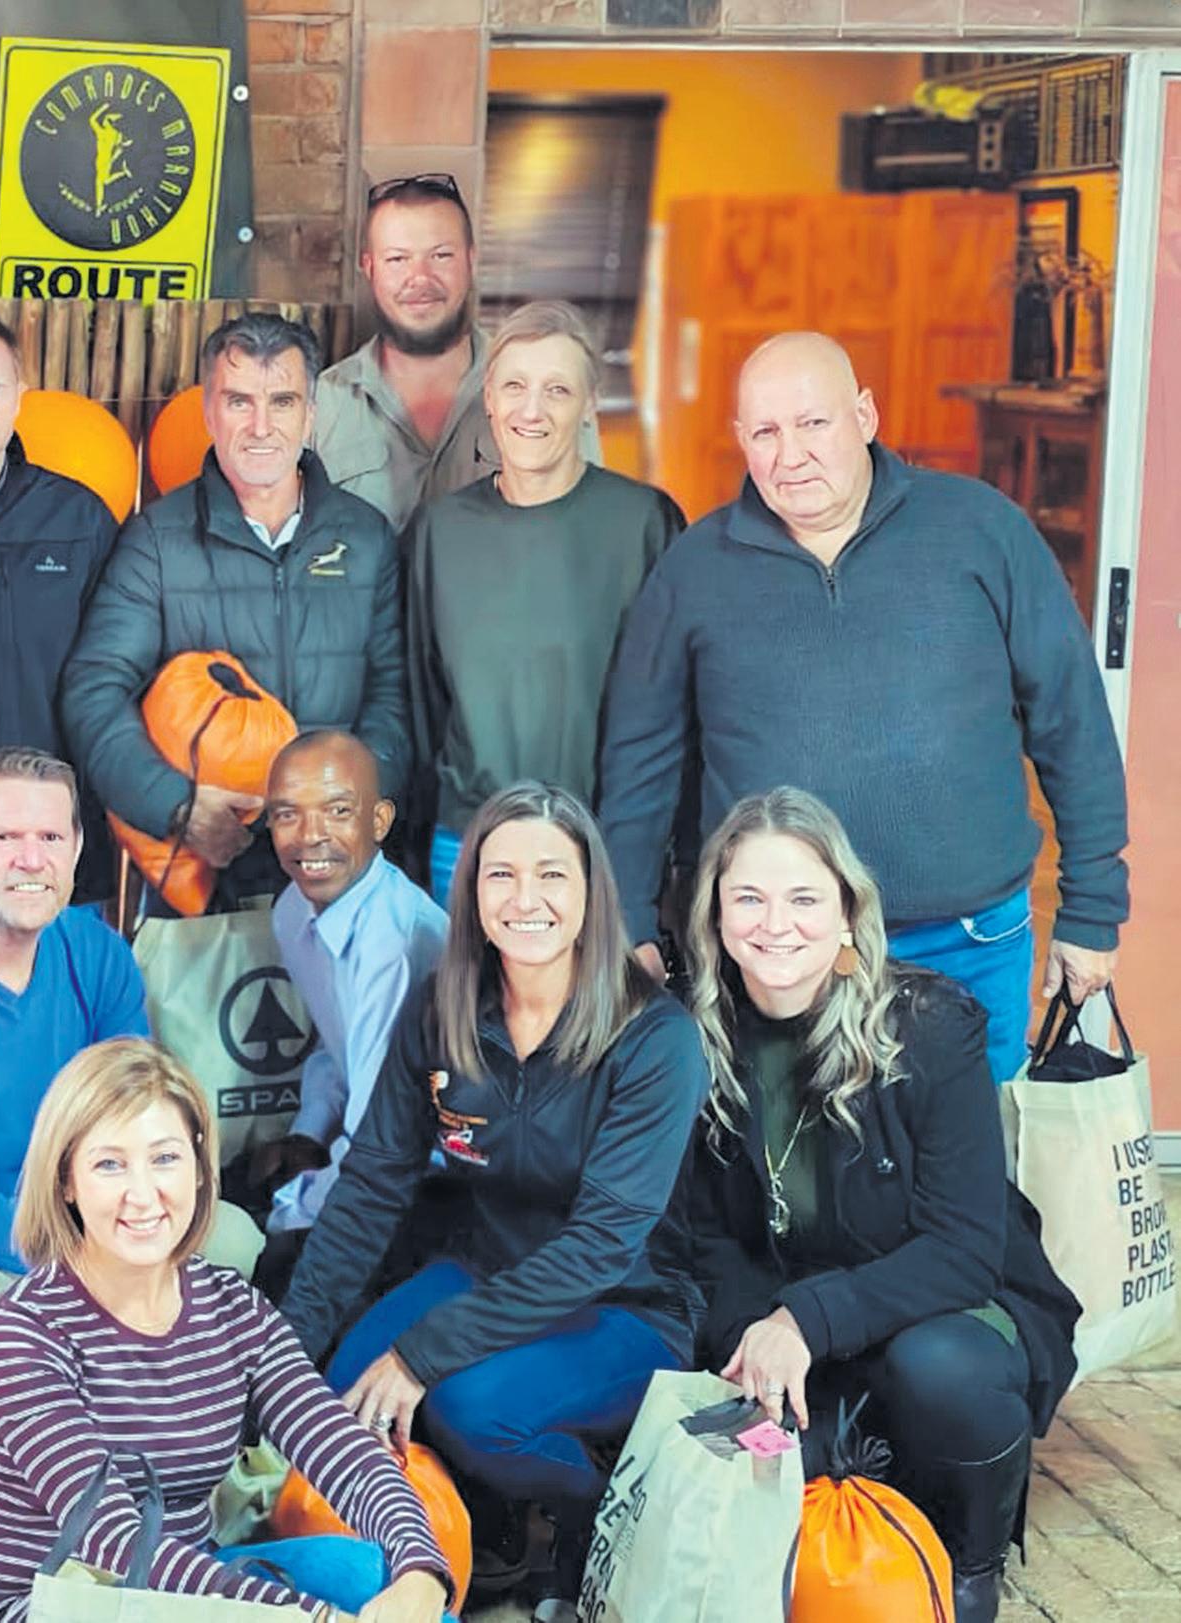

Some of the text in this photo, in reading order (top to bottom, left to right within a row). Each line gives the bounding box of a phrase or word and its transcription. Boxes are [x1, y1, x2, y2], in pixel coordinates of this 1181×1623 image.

[35, 71, 190, 244] COMRADES MARATHON
[13, 264, 188, 299] ROUTE
[220, 1088, 299, 1113] SPA
[1112, 1134, 1153, 1172] I USE
[1118, 1175, 1143, 1206] BE
[1128, 1230, 1172, 1272] PLAST
